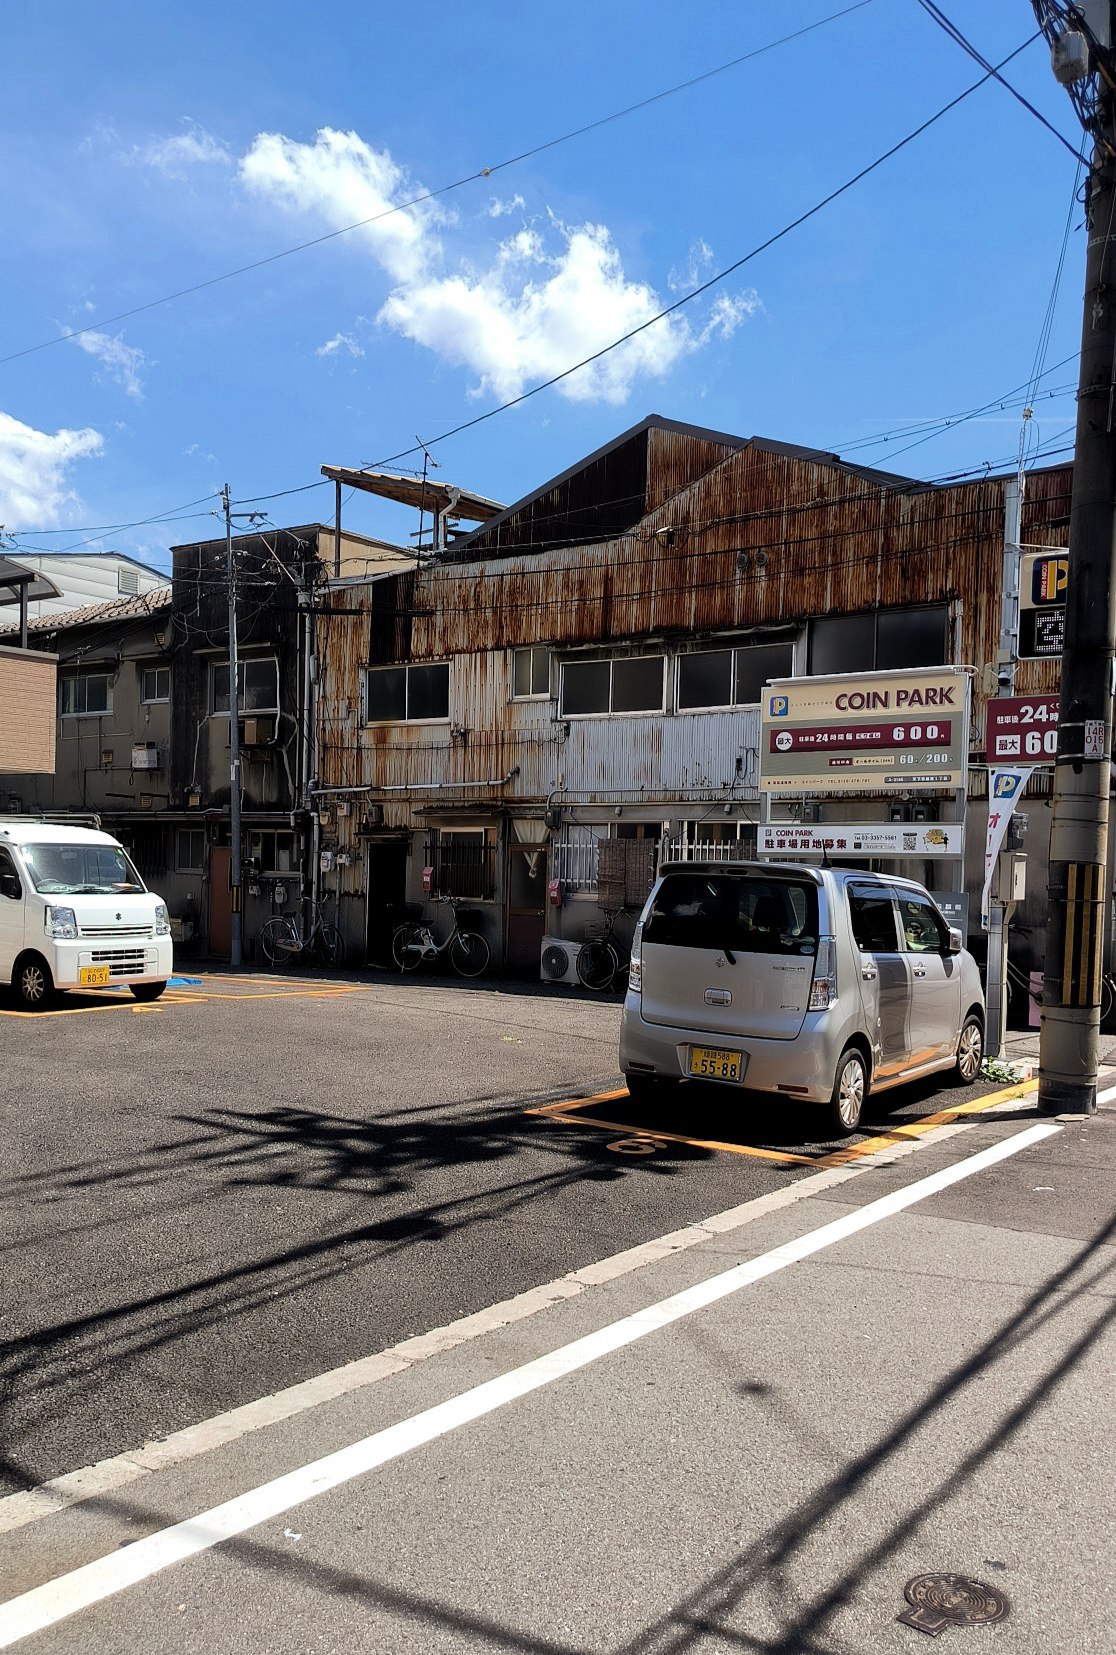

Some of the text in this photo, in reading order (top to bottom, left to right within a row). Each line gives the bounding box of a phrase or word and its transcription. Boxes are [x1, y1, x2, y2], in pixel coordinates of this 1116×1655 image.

[835, 691, 889, 711] COIN
[896, 686, 956, 706] PARK
[998, 739, 1018, 751] 最大
[1092, 744, 1098, 752] A
[776, 829, 794, 837] COIN
[795, 829, 813, 837] PARK
[764, 839, 847, 849] 駐車場用地募集
[87, 973, 108, 983] 80-51
[700, 1059, 737, 1077] 55-88
